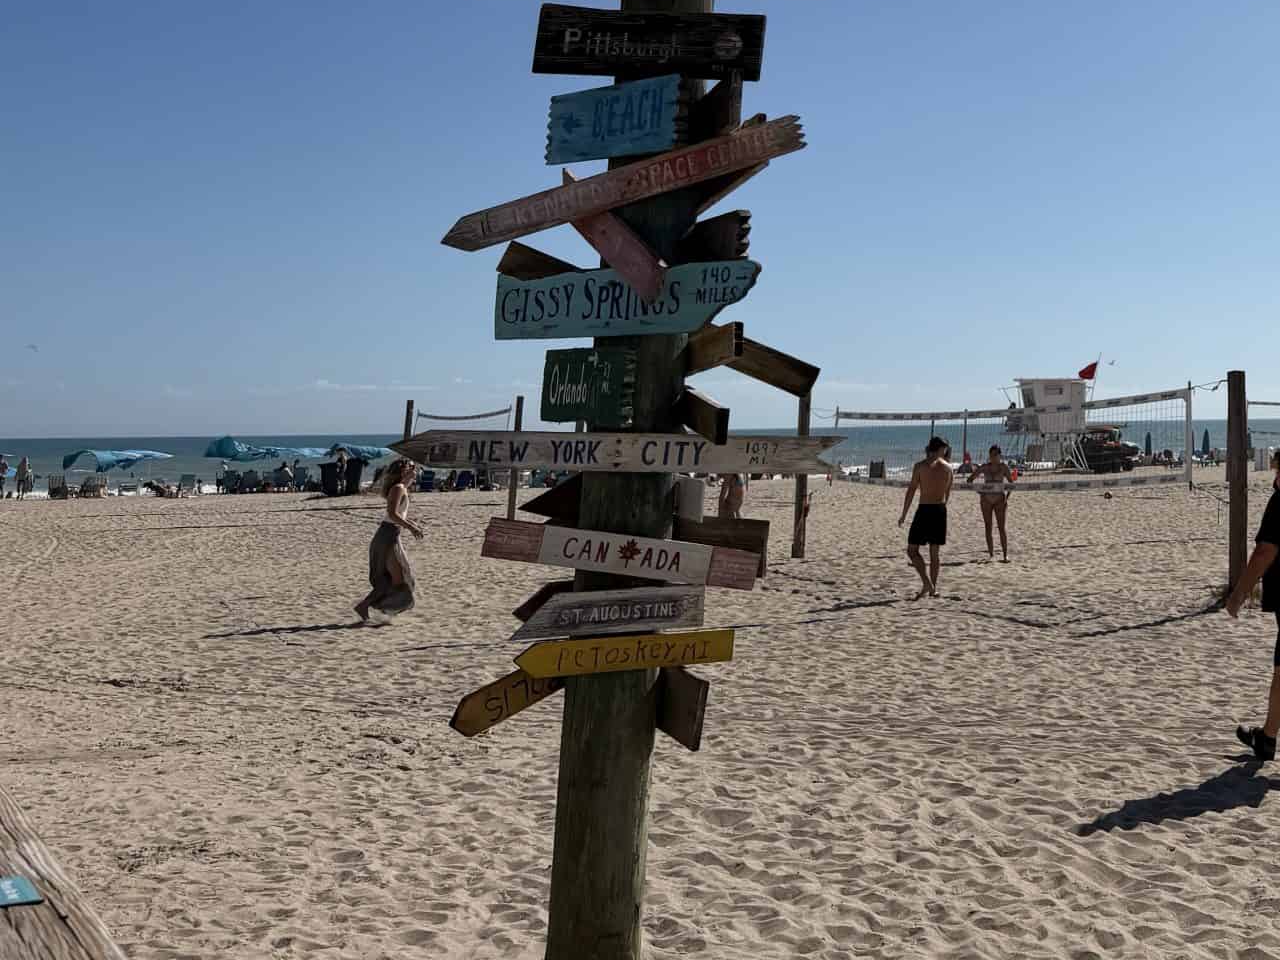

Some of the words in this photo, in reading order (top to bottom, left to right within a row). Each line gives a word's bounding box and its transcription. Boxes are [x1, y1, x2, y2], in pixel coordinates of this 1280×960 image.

[563, 27, 681, 65] Pittsburgh
[592, 87, 664, 139] BEACH
[638, 152, 698, 186] SPACE
[701, 266, 730, 284] 140
[501, 283, 575, 324] GISSY
[695, 286, 736, 305] MILES
[549, 362, 588, 406] Orlando
[468, 439, 529, 464] NEW
[550, 439, 601, 465] YORK
[640, 440, 707, 466] CITY
[745, 441, 779, 456] 1097
[589, 601, 676, 623] AUGUSTINE
[681, 640, 711, 661] MI
